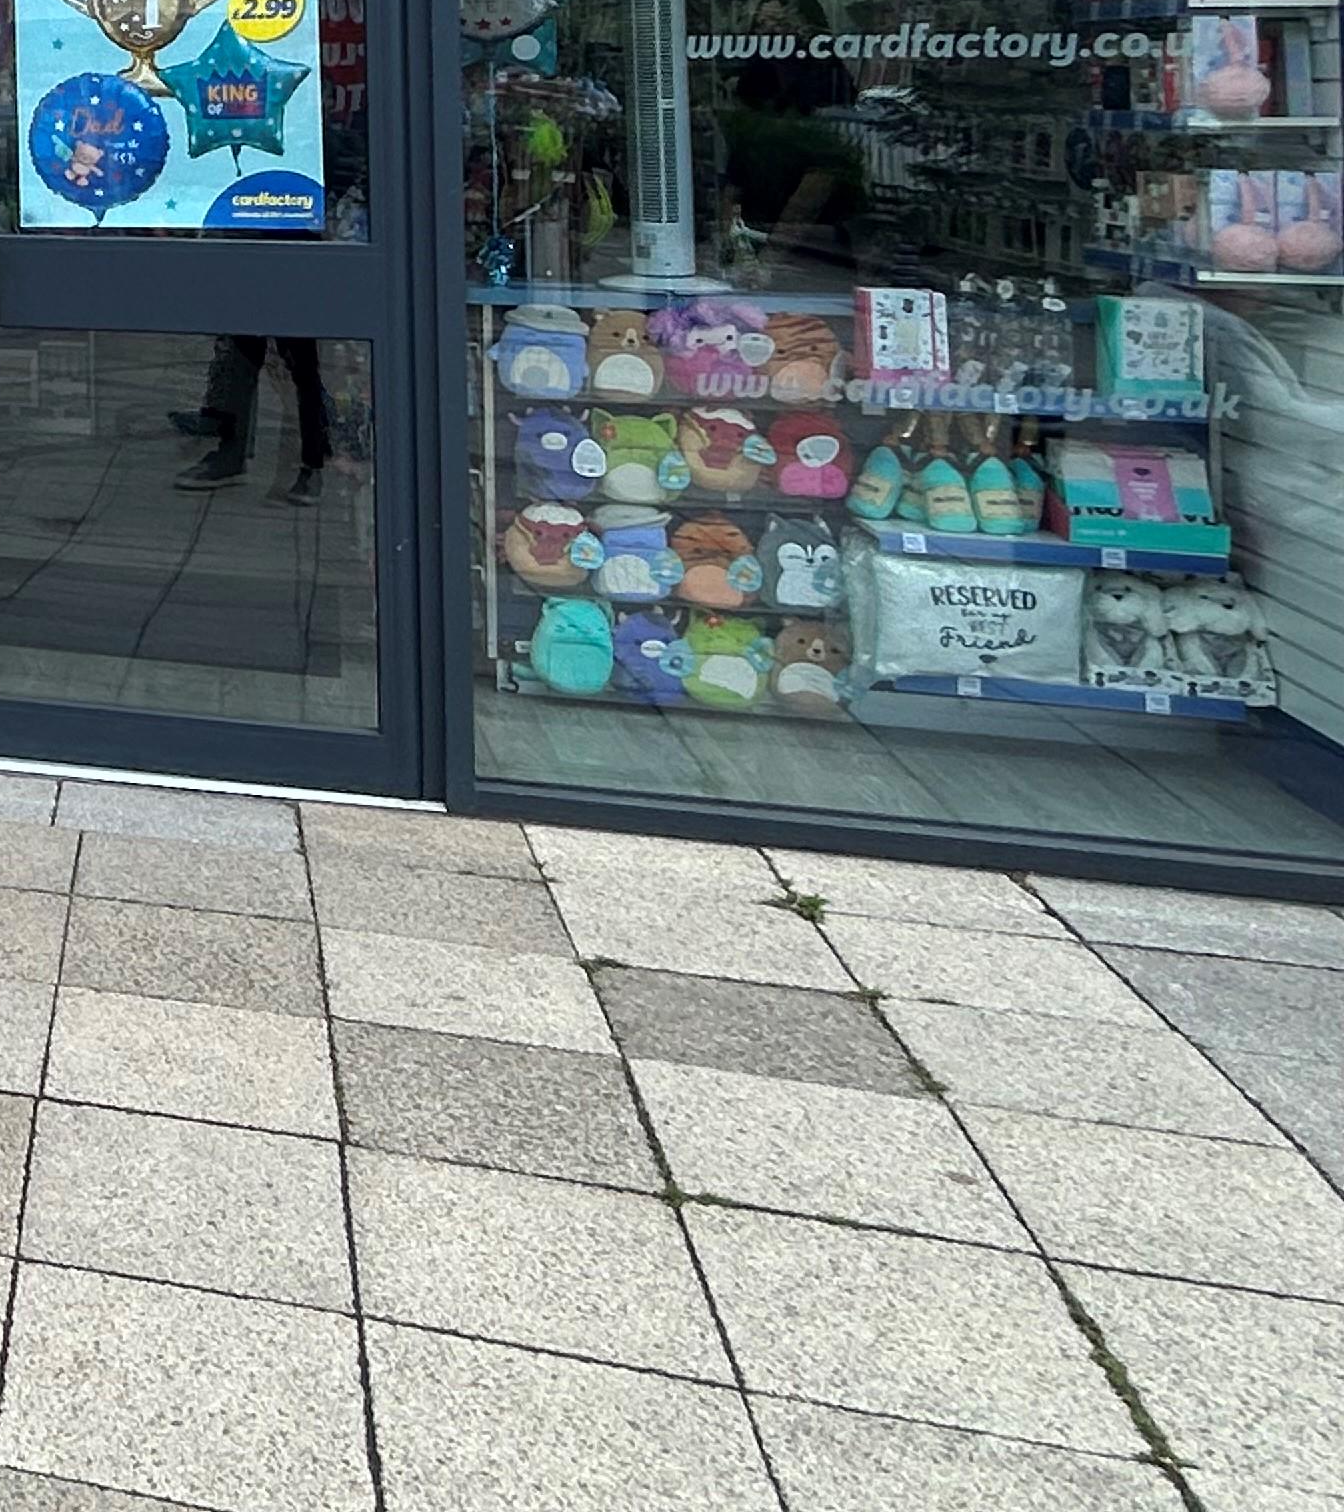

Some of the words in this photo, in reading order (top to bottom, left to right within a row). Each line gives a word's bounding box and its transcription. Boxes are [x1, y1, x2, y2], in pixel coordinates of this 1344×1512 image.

[686, 23, 1196, 66] www.cardfactory.co.u
[207, 84, 258, 102] KING
[232, 190, 314, 210] cardfactory
[930, 585, 1038, 610] RESERVED
[939, 626, 1039, 651] Friend
